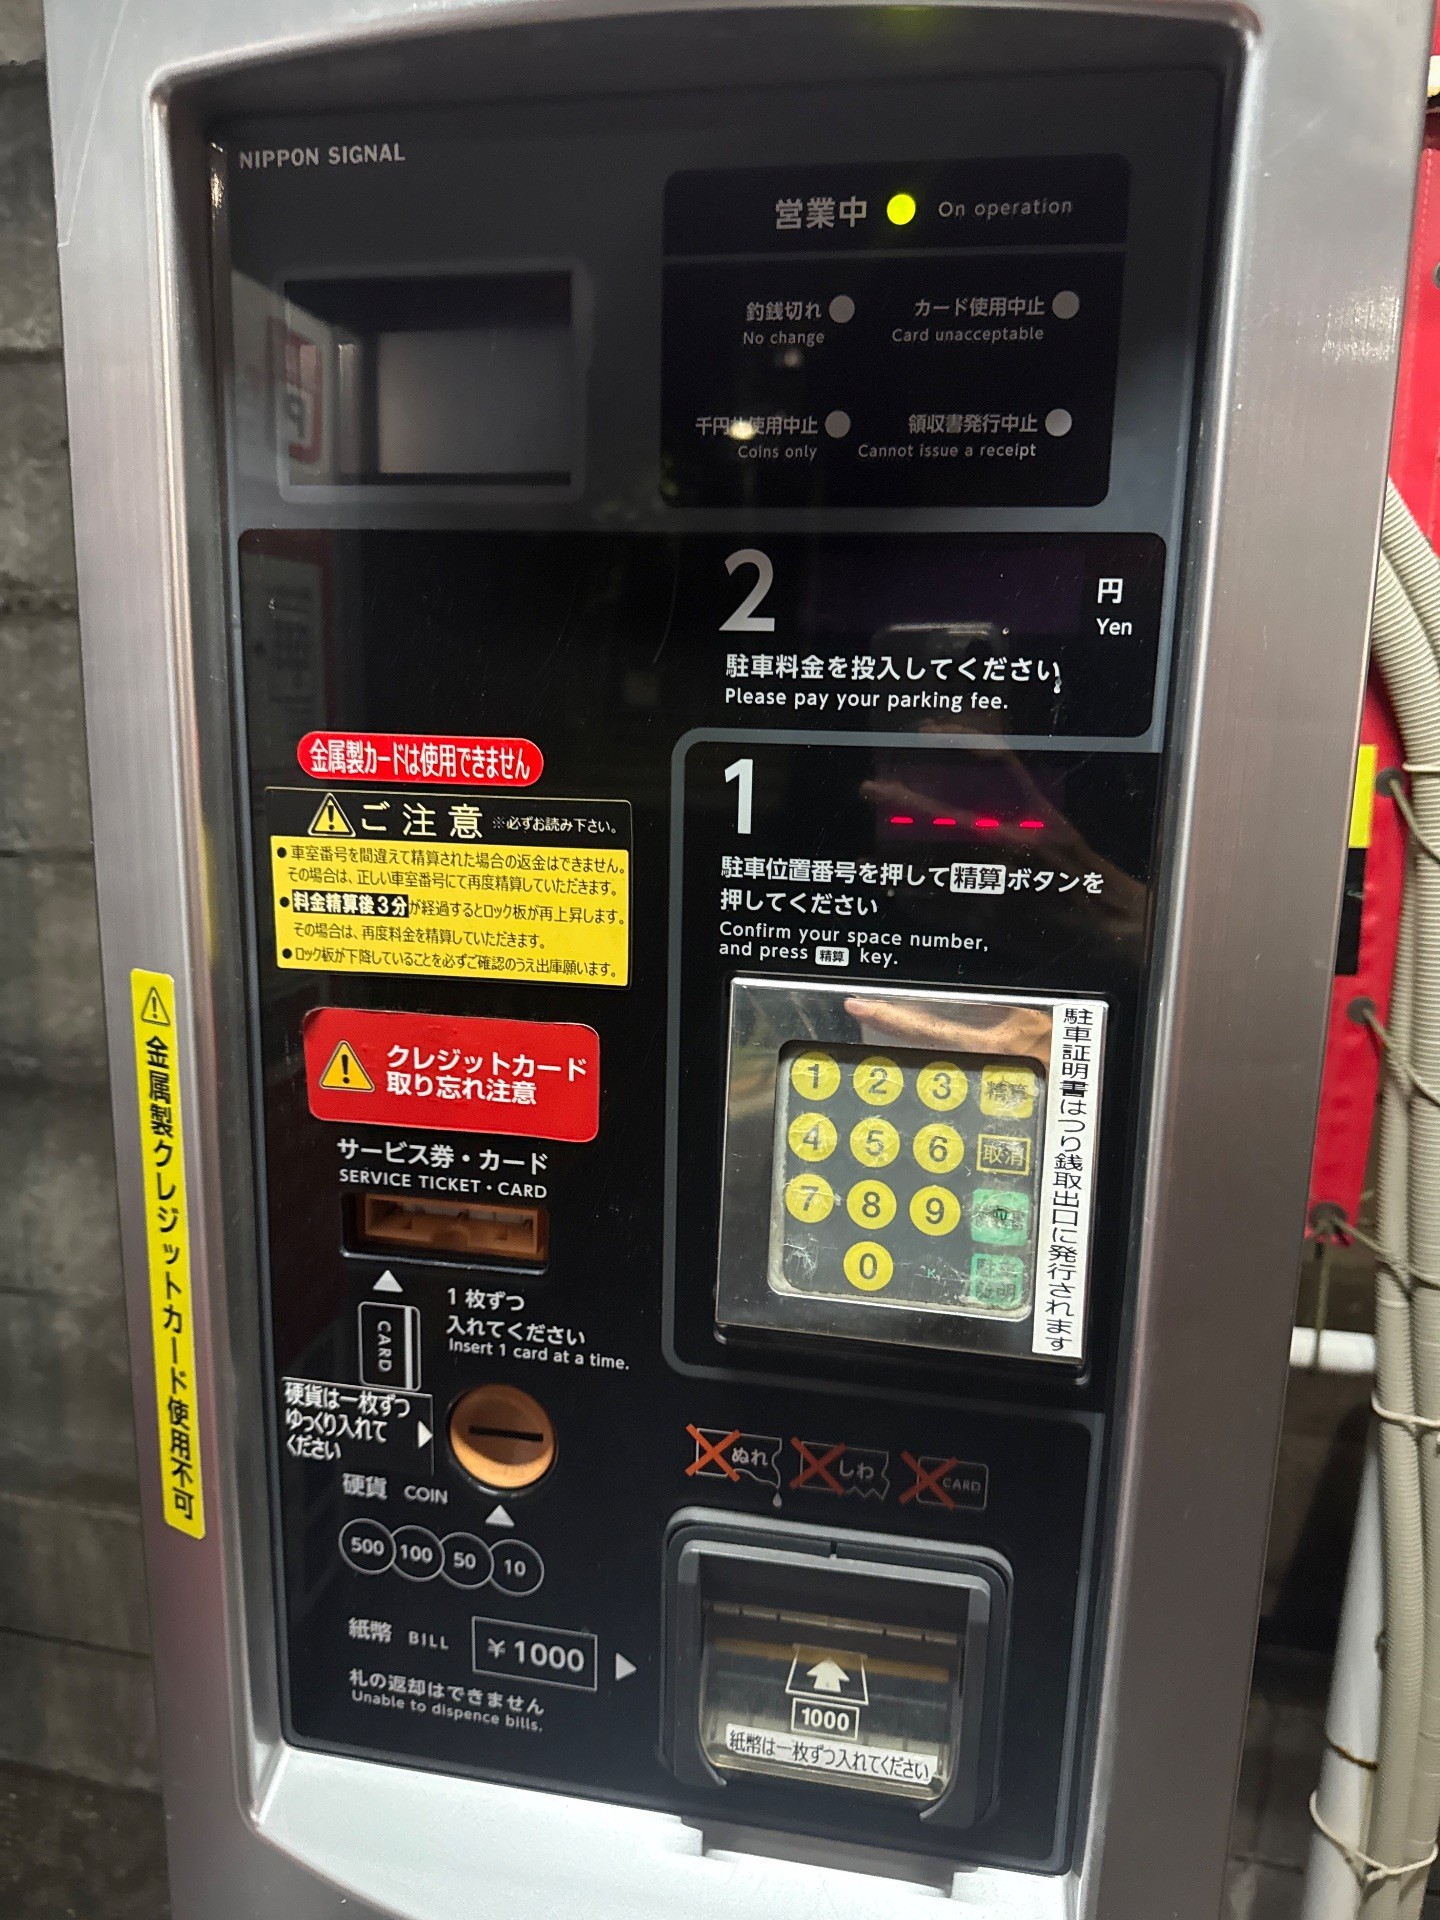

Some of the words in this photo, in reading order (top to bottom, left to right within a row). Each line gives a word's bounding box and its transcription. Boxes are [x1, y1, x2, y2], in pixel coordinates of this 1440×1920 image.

[240, 148, 319, 169] NIPPON
[328, 143, 406, 165] SIGNAL
[775, 196, 867, 231] 営業中
[938, 200, 966, 219] On
[975, 198, 1073, 222] operation
[746, 301, 822, 323] 釣銭切れ
[914, 297, 1045, 319] カード使用中止
[743, 330, 765, 345] No
[770, 329, 825, 348] change
[892, 327, 929, 343] Card
[936, 326, 1044, 345] unacceptable
[695, 415, 819, 437] 千円使用中止
[908, 413, 1038, 434] 領収書発行中止
[738, 444, 779, 459] Coins
[785, 444, 818, 461] only
[858, 443, 914, 459] Cannot
[919, 444, 959, 458] issue
[964, 447, 974, 457] a
[979, 442, 1036, 461] receipt
[719, 548, 776, 632] 2
[1097, 577, 1123, 604] 円
[1096, 617, 1132, 637] Yen
[725, 653, 1060, 682] 駐車料金を投入してください
[725, 687, 787, 706] Please
[794, 690, 829, 711] pay
[836, 691, 880, 711] your
[887, 691, 963, 713] parking
[971, 691, 1009, 711] fee.
[309, 738, 530, 781] 金属製カードは使用できません
[724, 758, 754, 835] 1
[720, 889, 878, 916] 押してください
[719, 921, 791, 941] Confirm
[799, 926, 841, 945] your
[847, 928, 902, 947] space
[909, 931, 989, 952] number,
[719, 941, 753, 957] and
[759, 943, 809, 961] press
[817, 948, 847, 965] 精算
[860, 948, 898, 967] key.
[386, 1045, 587, 1082] クレジットカード
[386, 1073, 537, 1106] 取り忘れ注意
[807, 1063, 821, 1089] 1
[868, 1067, 887, 1095] 2
[932, 1072, 952, 1100] 3
[803, 1125, 819, 1151] 4
[865, 1130, 884, 1157] 5
[929, 1136, 948, 1162] 6
[340, 1169, 412, 1187] SERVICE
[1045, 1007, 1093, 1352] 駐車証明書はつり銭取出口に発行されます
[800, 1186, 819, 1211] 7
[862, 1191, 881, 1218] 8
[926, 1198, 944, 1225] 9
[146, 1035, 194, 1521] 金属製クレジットカード使用不可
[859, 1253, 878, 1280] 0
[446, 1315, 585, 1346] 入れてください
[376, 1320, 392, 1373] CARD
[449, 1338, 493, 1356] Insert
[499, 1344, 506, 1357] 1
[513, 1345, 548, 1362] card
[553, 1351, 569, 1364] at
[574, 1353, 584, 1365] a
[589, 1353, 630, 1371] time.
[284, 1381, 410, 1418] 硬貨は一枚ずつ
[285, 1408, 387, 1444] ゆっくり入れて
[285, 1435, 342, 1461] ください
[731, 1446, 769, 1467] ぬれ
[840, 1460, 874, 1480] しわ
[942, 1476, 981, 1494] CARD
[342, 1473, 388, 1500] 硬貨
[404, 1484, 449, 1504] COIN
[351, 1537, 385, 1557] 500
[400, 1544, 433, 1563] 100
[453, 1552, 476, 1570] 50
[504, 1559, 526, 1577] 10
[348, 1617, 392, 1644] 紙幣
[408, 1631, 449, 1650] BILL
[349, 1668, 544, 1717] 札の返却はできません
[351, 1690, 405, 1710] Unable
[411, 1699, 427, 1713] to
[432, 1701, 500, 1726] dispence
[505, 1712, 543, 1732] bills.
[801, 1707, 849, 1732] 1000
[729, 1729, 929, 1781] 紙幣は一枚ずつ入れてください
